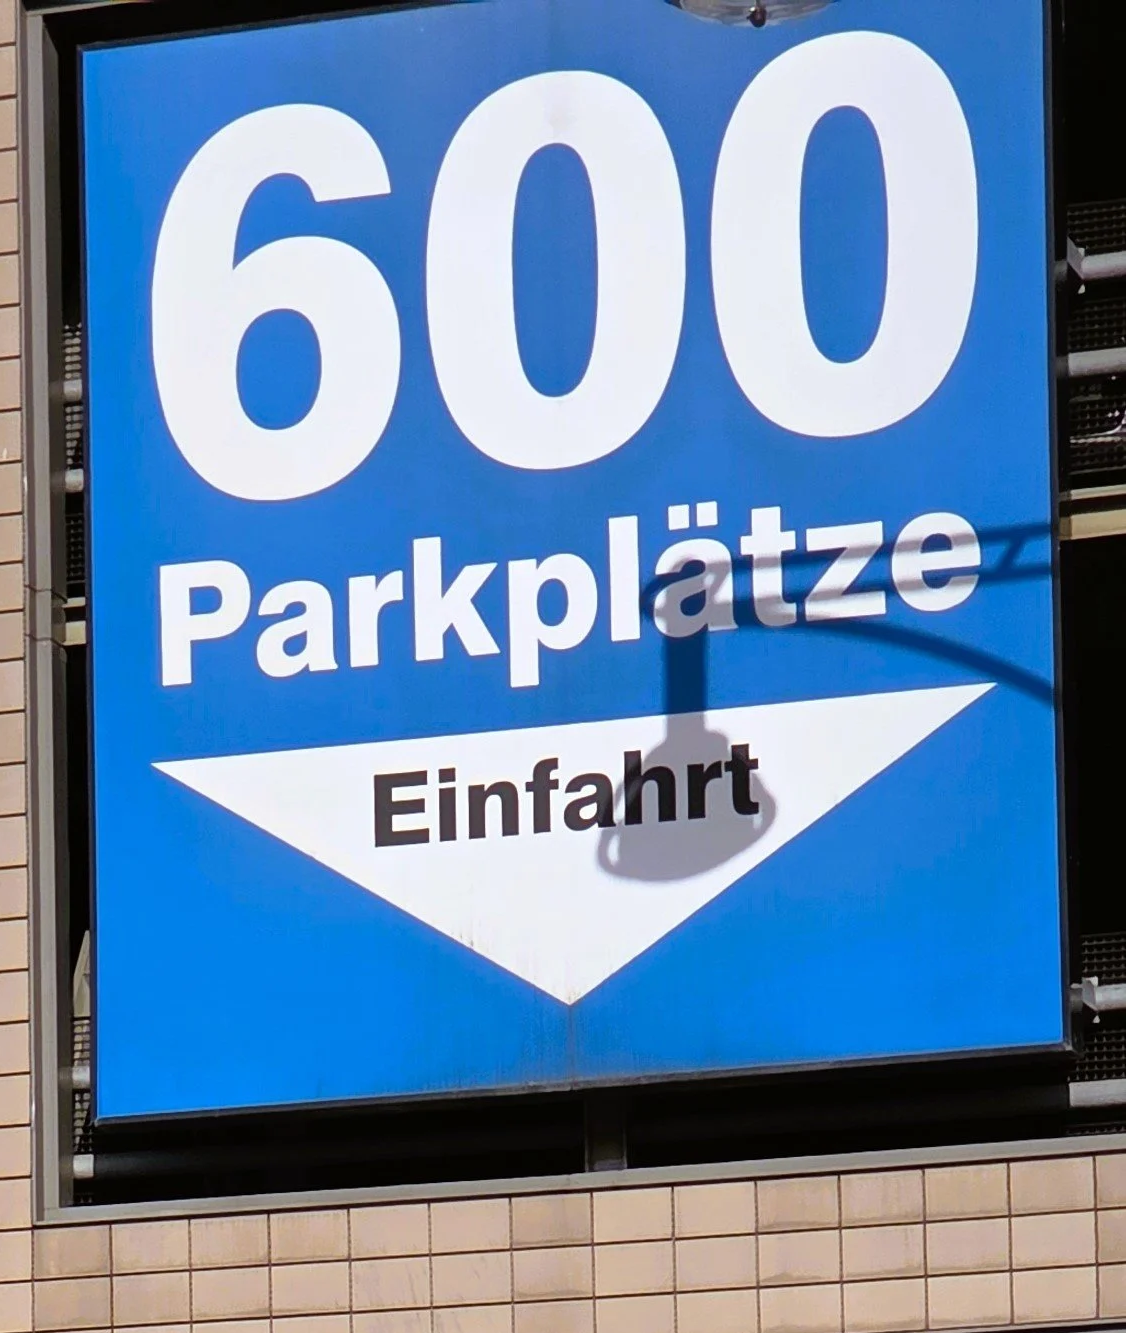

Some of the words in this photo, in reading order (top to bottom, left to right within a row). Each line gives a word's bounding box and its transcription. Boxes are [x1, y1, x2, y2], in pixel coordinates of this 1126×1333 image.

[151, 31, 978, 502] 600
[158, 502, 981, 688] Parkplätze
[372, 743, 760, 848] Einfahrt
